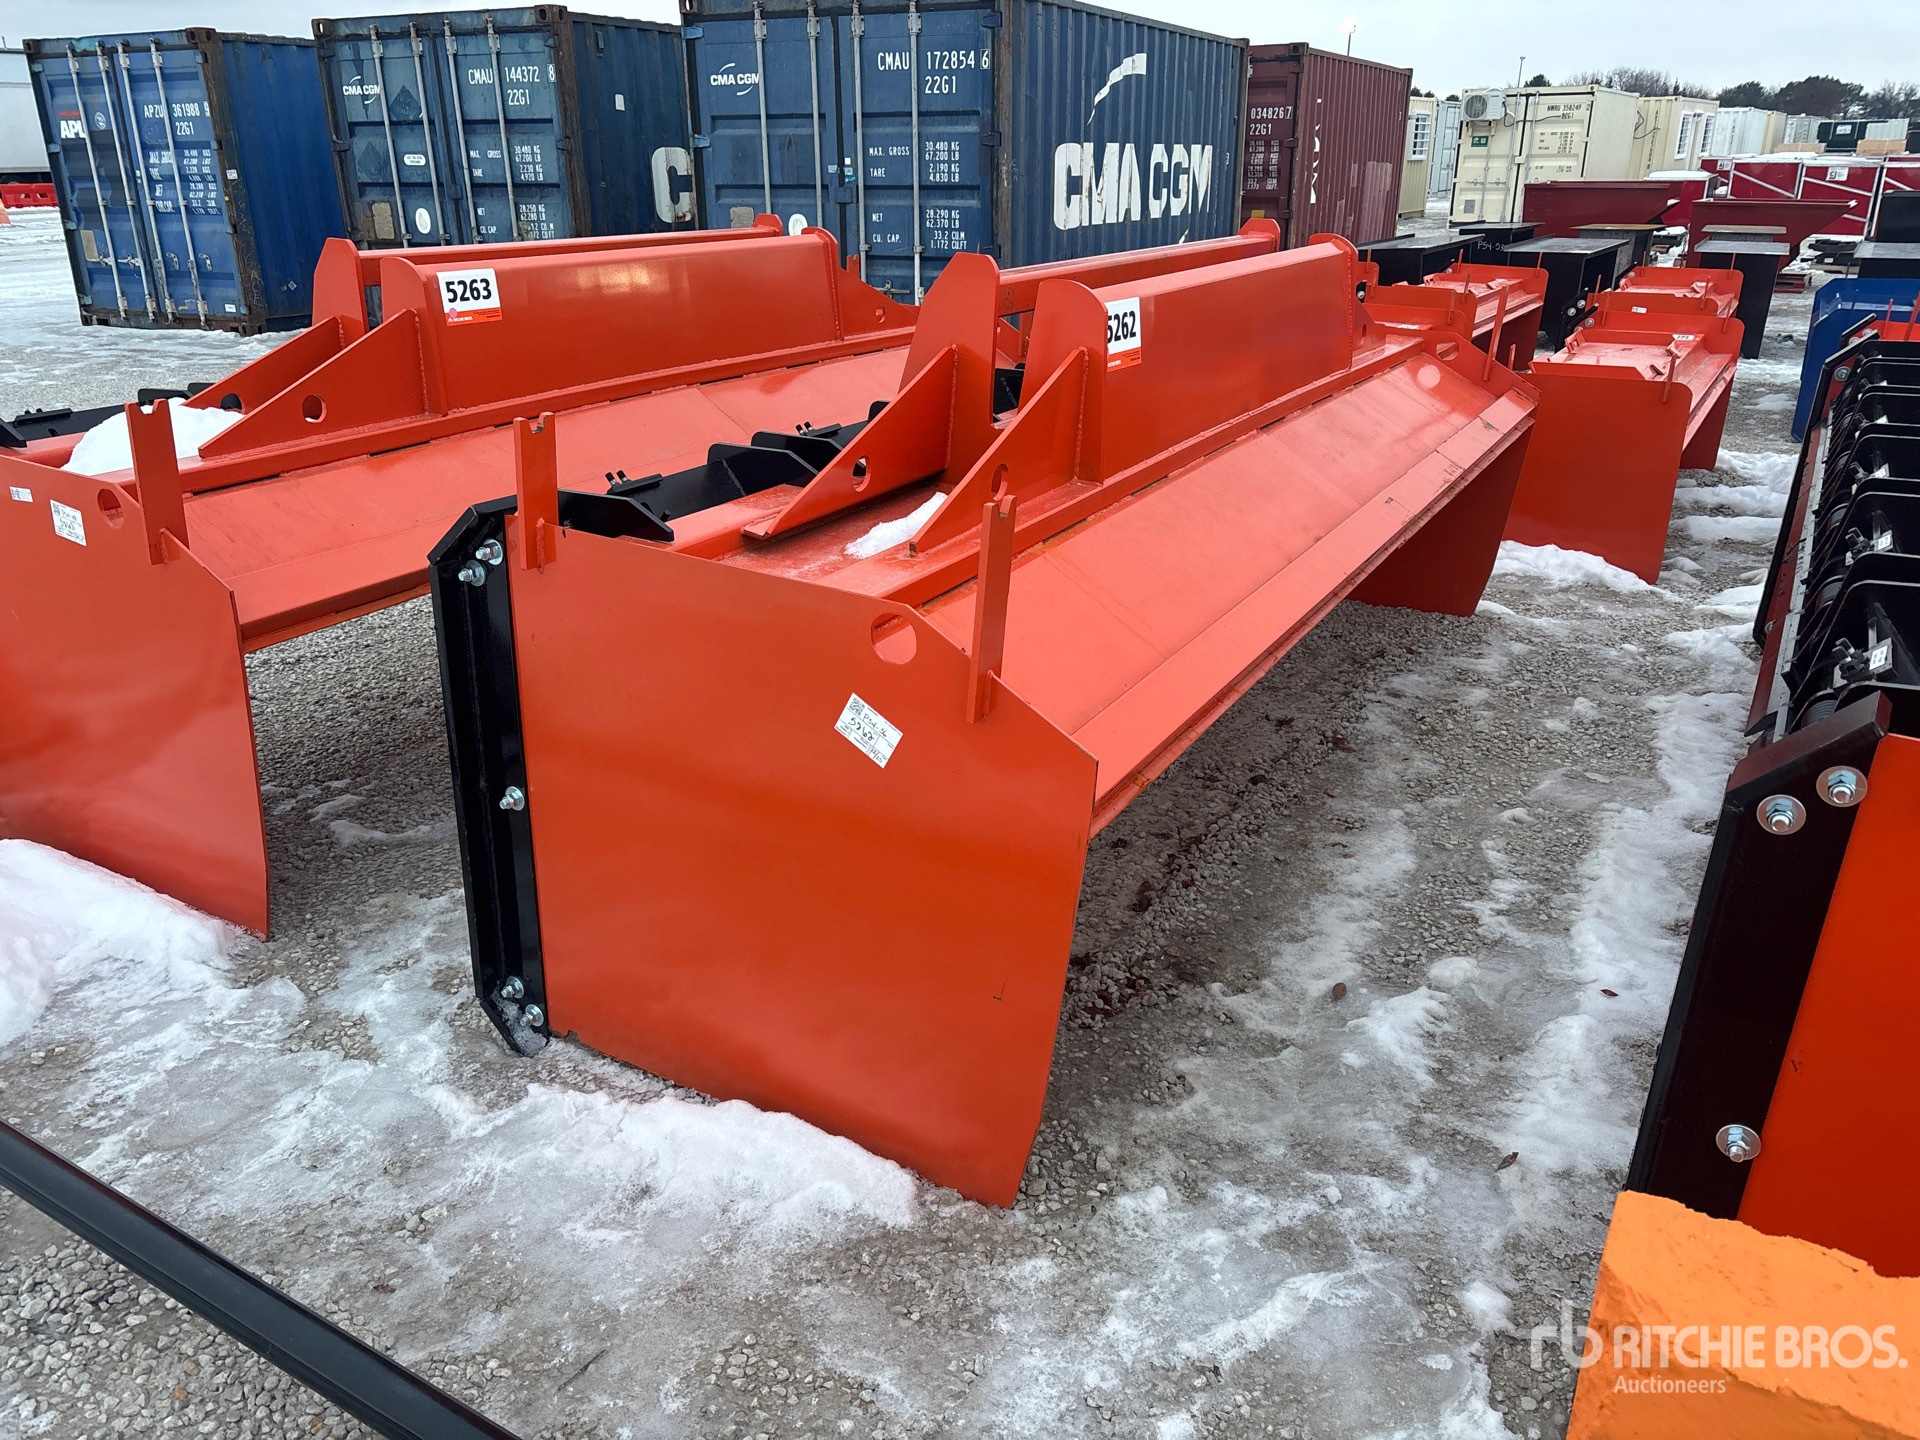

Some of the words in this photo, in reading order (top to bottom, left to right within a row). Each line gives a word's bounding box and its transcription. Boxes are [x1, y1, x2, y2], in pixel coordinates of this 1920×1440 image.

[878, 52, 909, 70] CMAU
[927, 51, 975, 69] 172854
[982, 51, 989, 68] 6
[468, 68, 494, 84] CMAU
[505, 66, 540, 82] 144372
[548, 65, 556, 80] 8
[710, 74, 736, 85] CMA
[737, 73, 759, 84] CGM
[343, 86, 363, 95] CMA
[363, 84, 381, 95] CGM
[925, 76, 956, 93] 22G1
[507, 89, 530, 105] 22G1
[144, 104, 164, 118] APZU
[172, 103, 200, 117] 361988
[1251, 107, 1285, 119] 034826
[1286, 107, 1292, 118] 7
[60, 120, 86, 138] APL
[1249, 123, 1272, 135] 22G1
[487, 150, 502, 158] GROSS
[534, 145, 540, 154] KG
[869, 147, 885, 156] MAX.
[889, 147, 910, 155] GROSS
[925, 142, 948, 150] 30.480
[951, 142, 960, 150] KG
[534, 154, 542, 162] LB
[925, 152, 948, 160] 67.200
[951, 152, 960, 160] LB
[472, 168, 484, 177] TARE
[536, 165, 543, 173] KG
[870, 168, 886, 177] TARE
[929, 164, 948, 172] 2.190
[951, 164, 960, 172] KG
[536, 173, 544, 181] LB
[929, 173, 948, 182] 4.830
[951, 174, 960, 182] LB
[1053, 142, 1142, 230] CMA
[1148, 144, 1213, 218] CGM
[477, 208, 486, 216] NET
[538, 204, 546, 212] KG
[540, 212, 546, 220] LB
[872, 213, 883, 222] NET
[926, 210, 948, 218] 28.290
[951, 210, 960, 218] KG
[926, 220, 948, 228] 62.370
[951, 220, 960, 228] LB
[887, 234, 902, 242] CAP.
[934, 231, 948, 240] 33.2
[930, 240, 948, 250] 1.172
[445, 278, 492, 303] 5263
[1107, 310, 1136, 344] 5262
[848, 717, 875, 741] 5262
